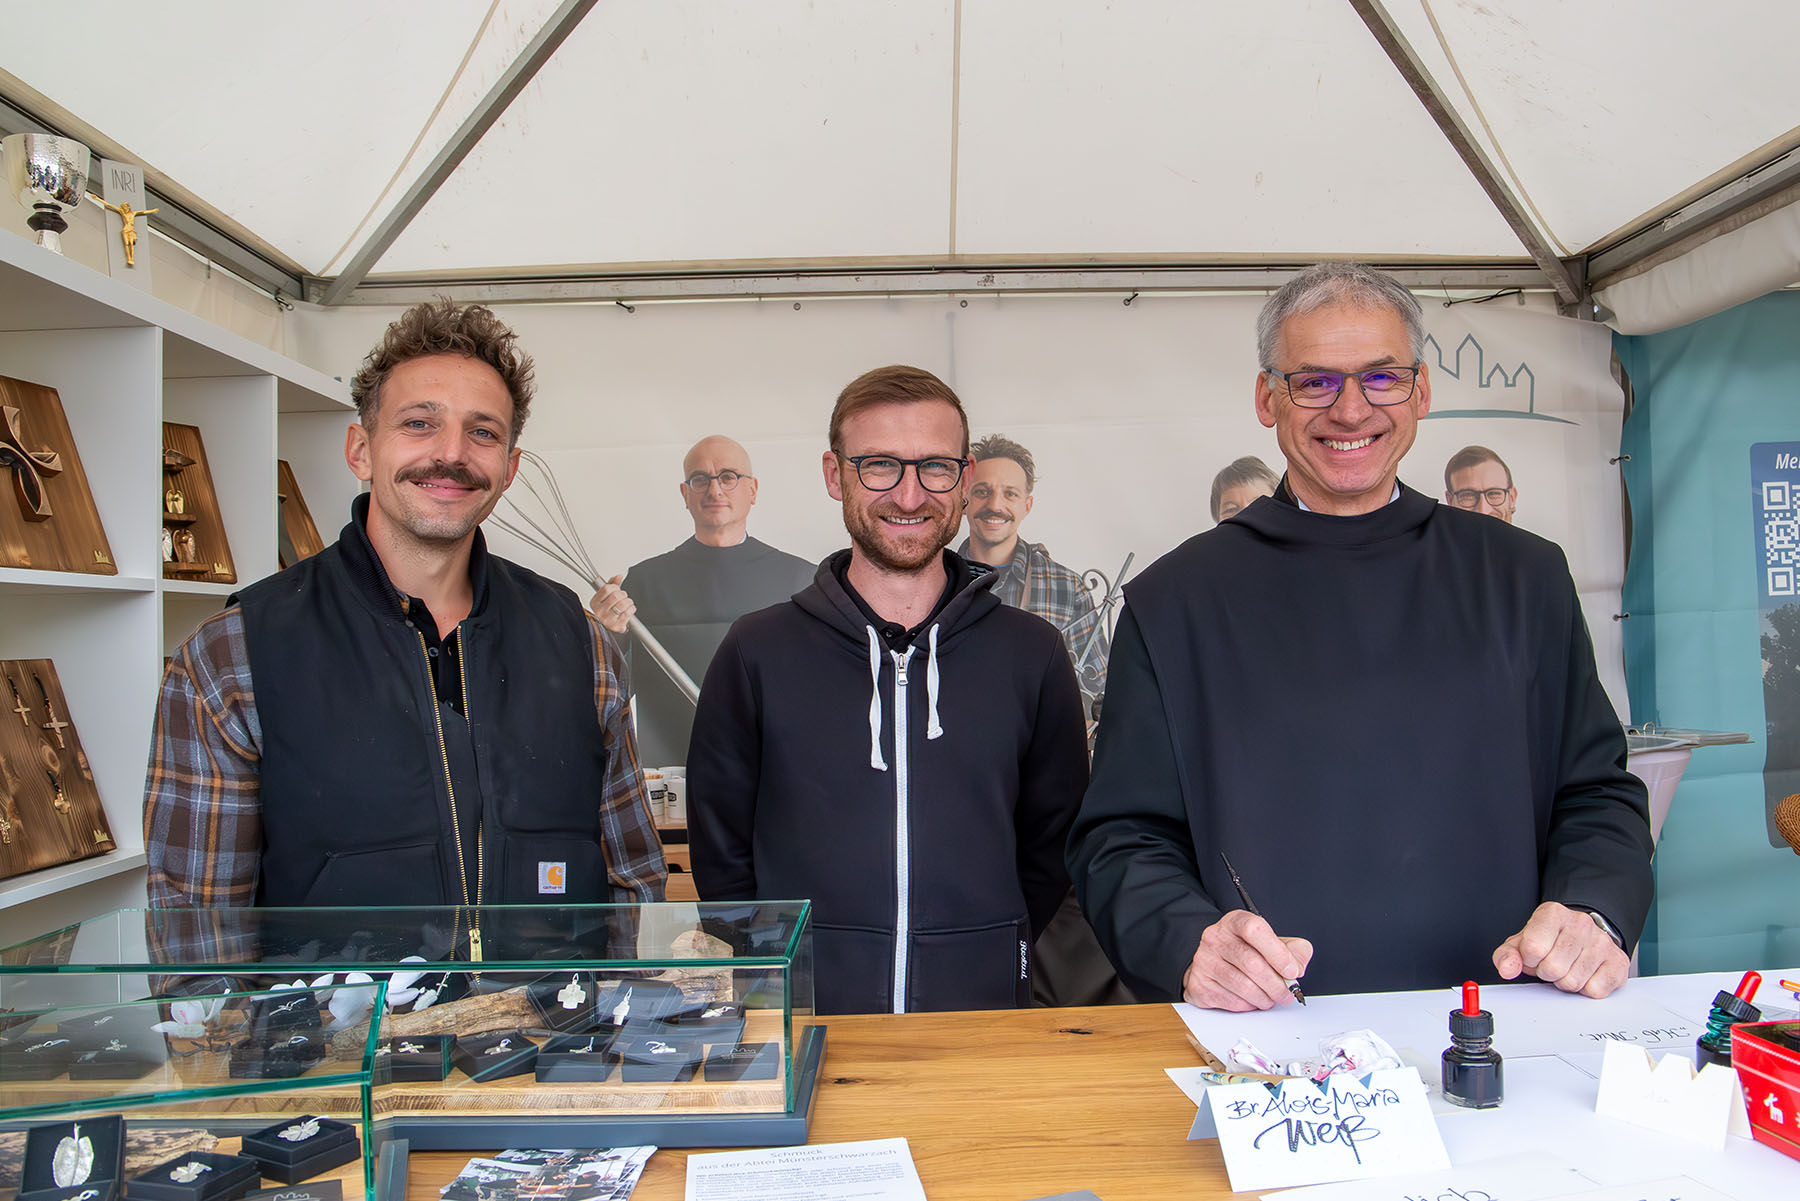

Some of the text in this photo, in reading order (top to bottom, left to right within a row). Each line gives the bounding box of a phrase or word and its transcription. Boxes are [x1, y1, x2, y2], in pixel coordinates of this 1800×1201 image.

[111, 168, 136, 193] INRI
[1226, 1087, 1400, 1121] Br. Alois-Maria
[770, 1149, 822, 1159] Schmuck
